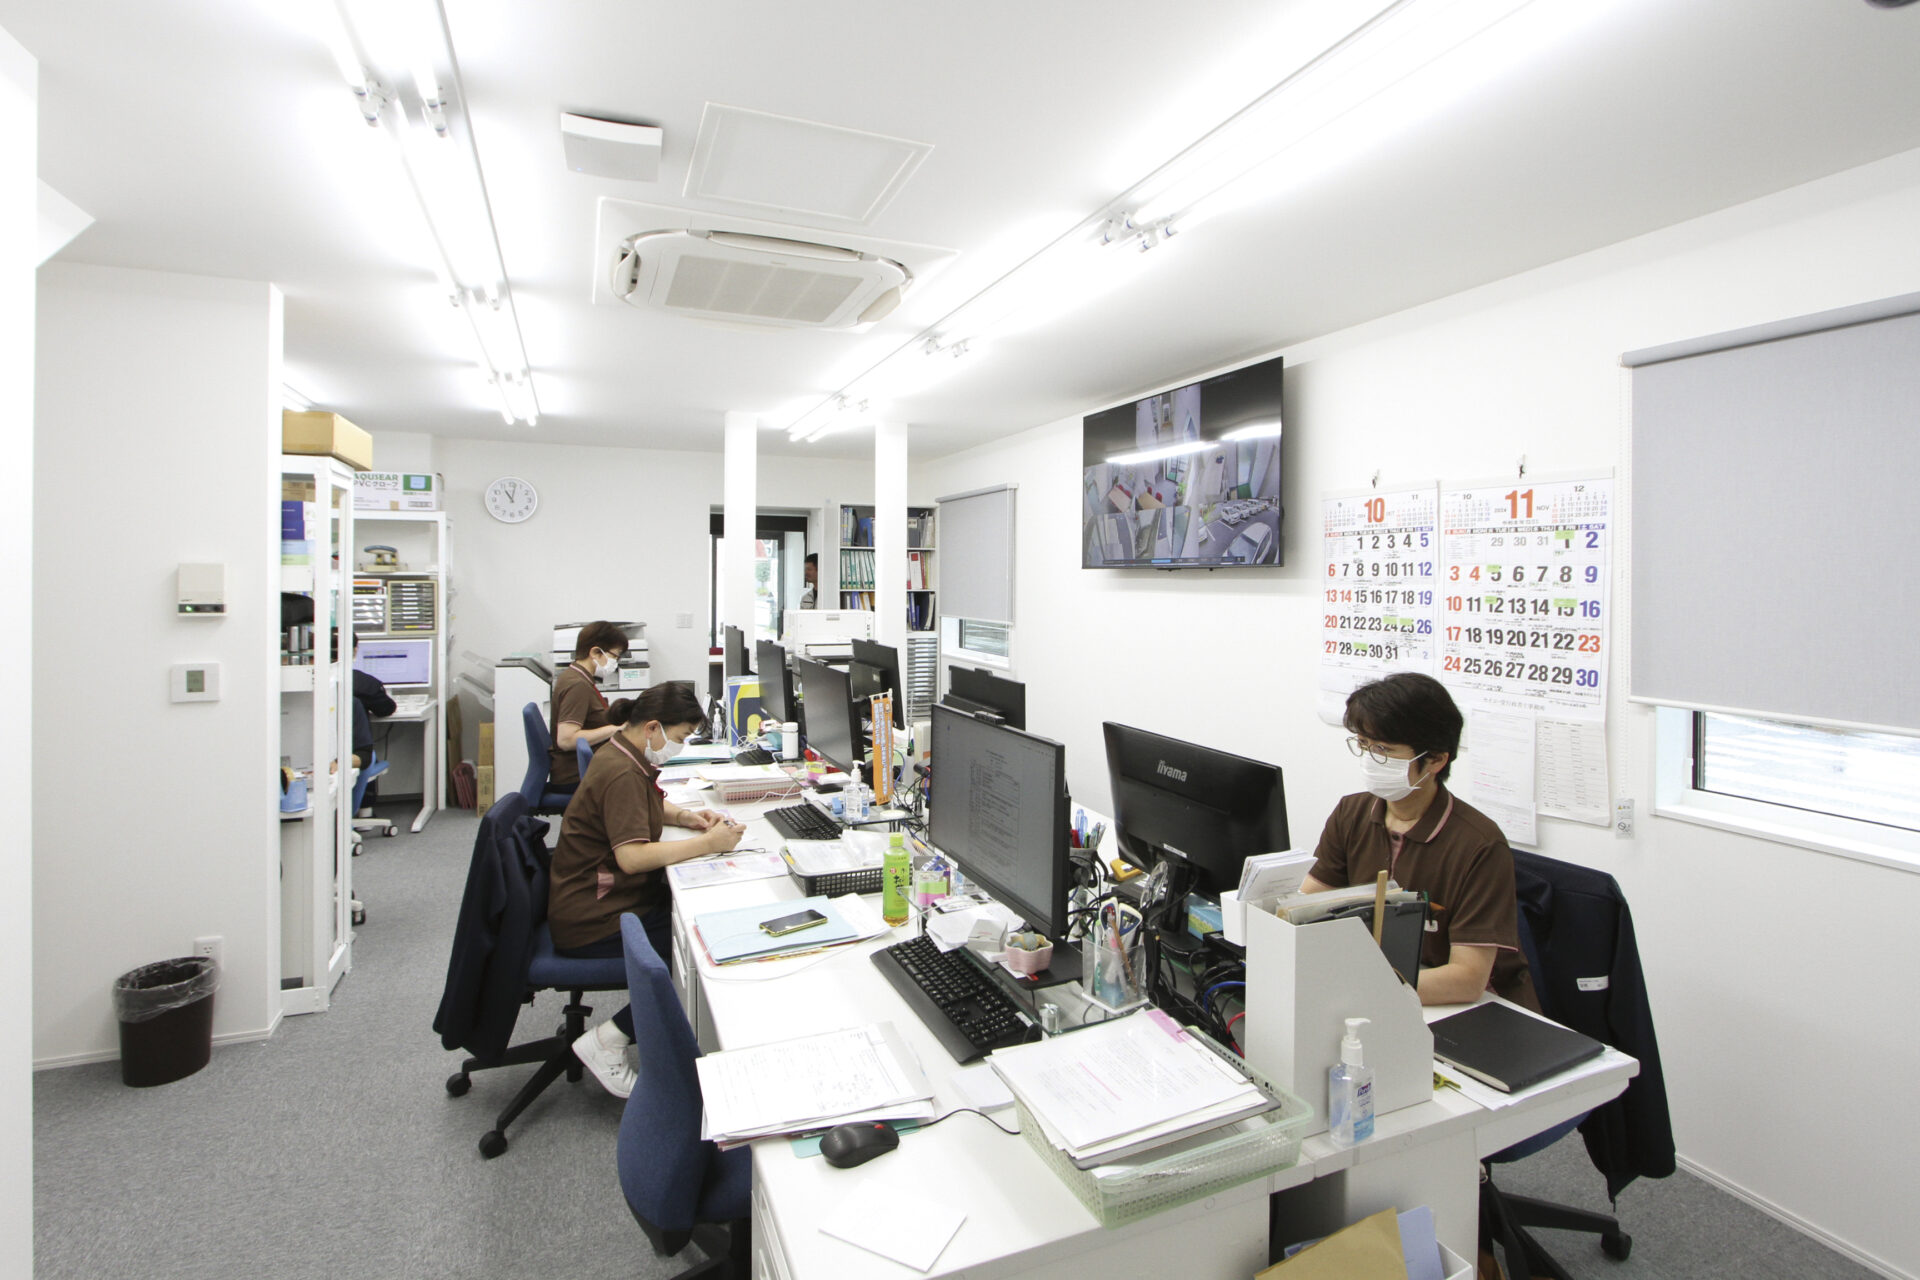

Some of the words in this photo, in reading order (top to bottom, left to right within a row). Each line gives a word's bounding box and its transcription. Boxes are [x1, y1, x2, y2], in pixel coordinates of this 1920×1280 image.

[1365, 498, 1385, 523] 10
[1505, 489, 1533, 519] 11
[1358, 537, 1362, 549] 1
[1372, 536, 1379, 549] 2
[1388, 535, 1395, 548] 3
[1403, 534, 1412, 547] 4
[1421, 533, 1428, 547] 5
[1491, 537, 1503, 546] 29
[1514, 537, 1527, 546] 30
[1537, 536, 1549, 545] 31
[1586, 532, 1598, 548] 2
[1329, 564, 1335, 576] 6
[1343, 564, 1349, 576] 7
[1357, 563, 1364, 576] 8
[1372, 563, 1379, 576] 9
[1385, 563, 1397, 576] 10
[1402, 563, 1413, 576] 11
[1418, 562, 1432, 576] 12
[1450, 566, 1459, 581] 3
[1470, 566, 1480, 581] 4
[1513, 566, 1524, 582] 6
[1537, 566, 1548, 582] 7
[1560, 566, 1572, 582] 8
[1585, 566, 1597, 583] 9
[1326, 590, 1337, 602] 13
[1340, 590, 1352, 602] 14
[1355, 590, 1367, 603] 15
[1370, 590, 1382, 603] 16
[1385, 591, 1398, 603] 17
[1401, 591, 1414, 604] 18
[1418, 591, 1432, 605] 19
[1446, 596, 1462, 611] 10
[1467, 597, 1480, 612] 11
[1489, 597, 1504, 613] 12
[1508, 598, 1526, 614] 13
[1531, 599, 1549, 615] 14
[1580, 601, 1600, 618] 16
[1325, 615, 1337, 628] 20
[1340, 616, 1350, 628] 21
[1354, 617, 1366, 630] 22
[1368, 617, 1381, 631] 23
[1417, 619, 1432, 634] 26
[1446, 627, 1461, 641] 17
[1465, 628, 1482, 643] 18
[1486, 629, 1503, 645] 19
[1507, 630, 1526, 646] 20
[1531, 632, 1548, 648] 21
[1553, 633, 1574, 650] 22
[1578, 635, 1600, 652] 23
[1326, 641, 1337, 653] 27
[1339, 642, 1352, 655] 28
[1369, 644, 1382, 658] 30
[1385, 645, 1398, 659] 31
[1444, 656, 1461, 671] 24
[1464, 658, 1481, 674] 25
[1484, 660, 1502, 676] 26
[1506, 662, 1525, 678] 27
[1528, 664, 1548, 682] 28
[1552, 667, 1572, 684] 29
[1576, 669, 1598, 687] 30
[1157, 760, 1188, 782] iiyama
